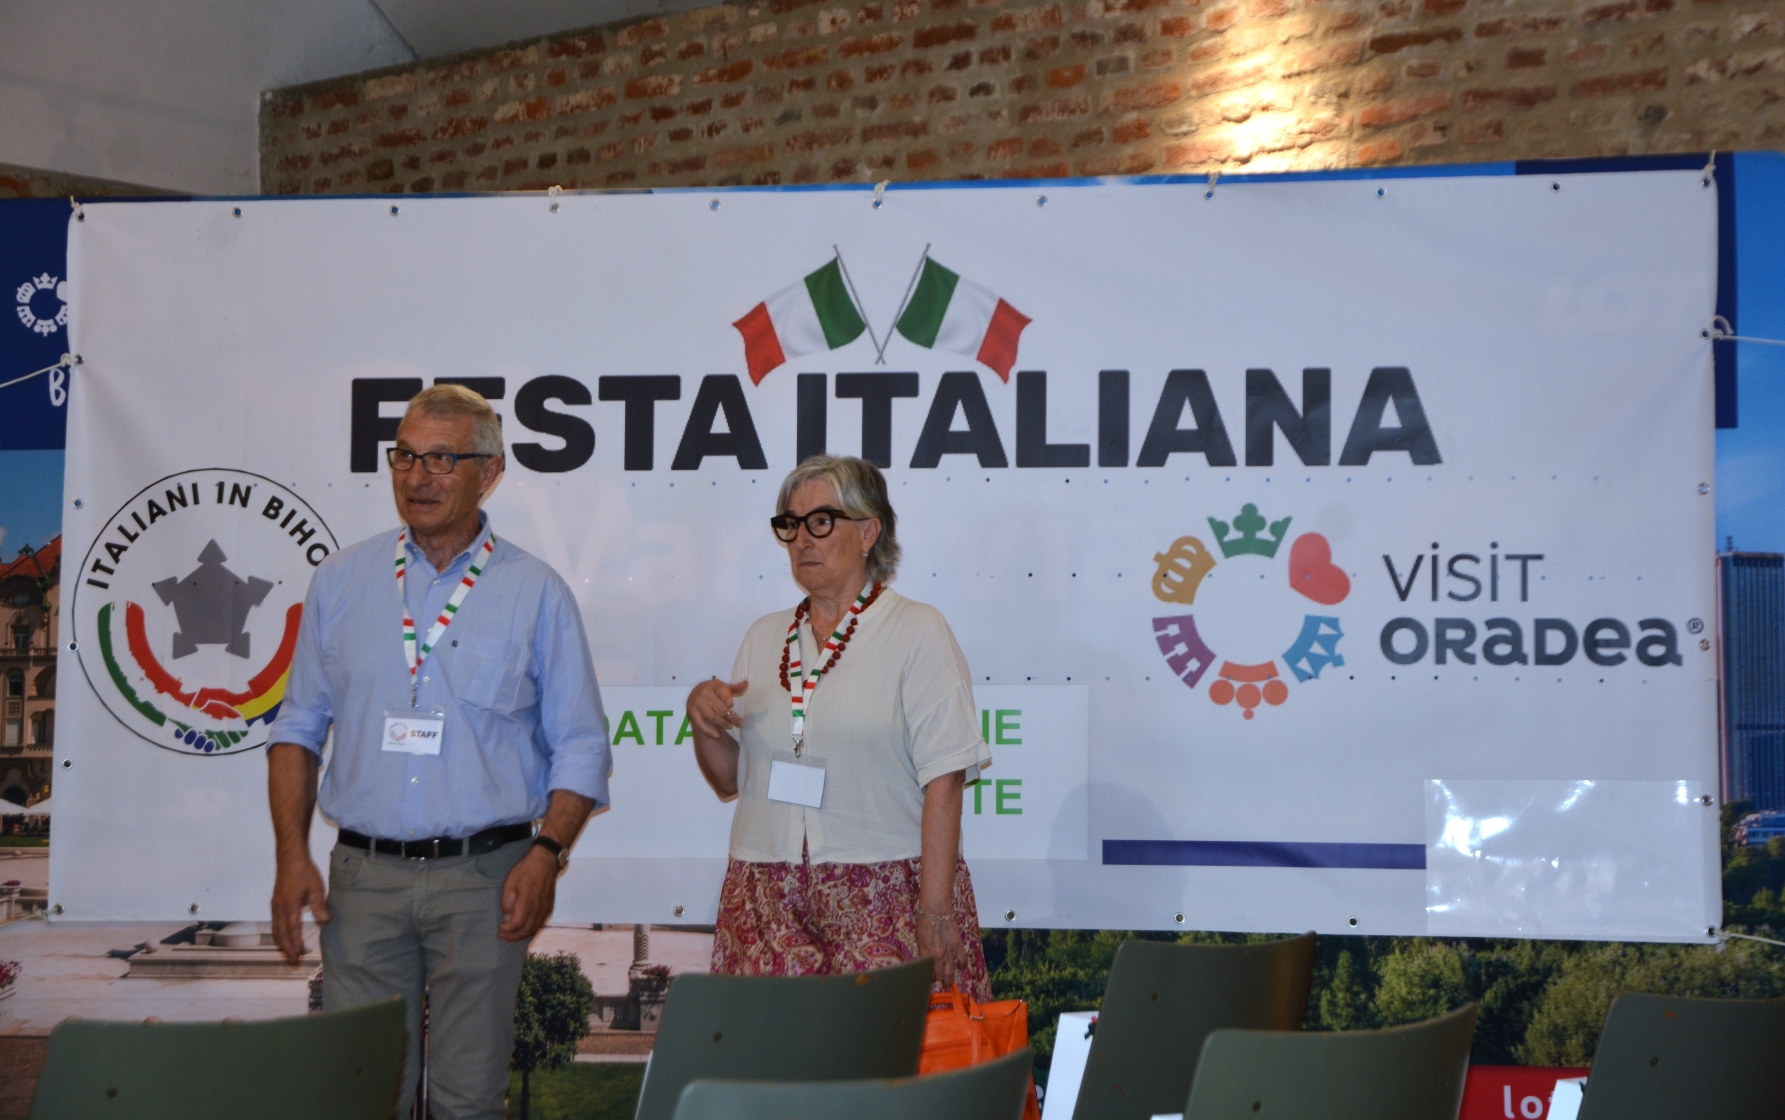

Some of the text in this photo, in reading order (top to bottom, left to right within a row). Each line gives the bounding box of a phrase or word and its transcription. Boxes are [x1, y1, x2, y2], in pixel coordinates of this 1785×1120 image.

[797, 366, 1443, 469] ITALIANA
[86, 481, 330, 590] ITALIANI IN BIHO
[410, 729, 439, 739] STAFF
[964, 779, 1023, 815] TE
[1503, 1085, 1554, 1119] lo
